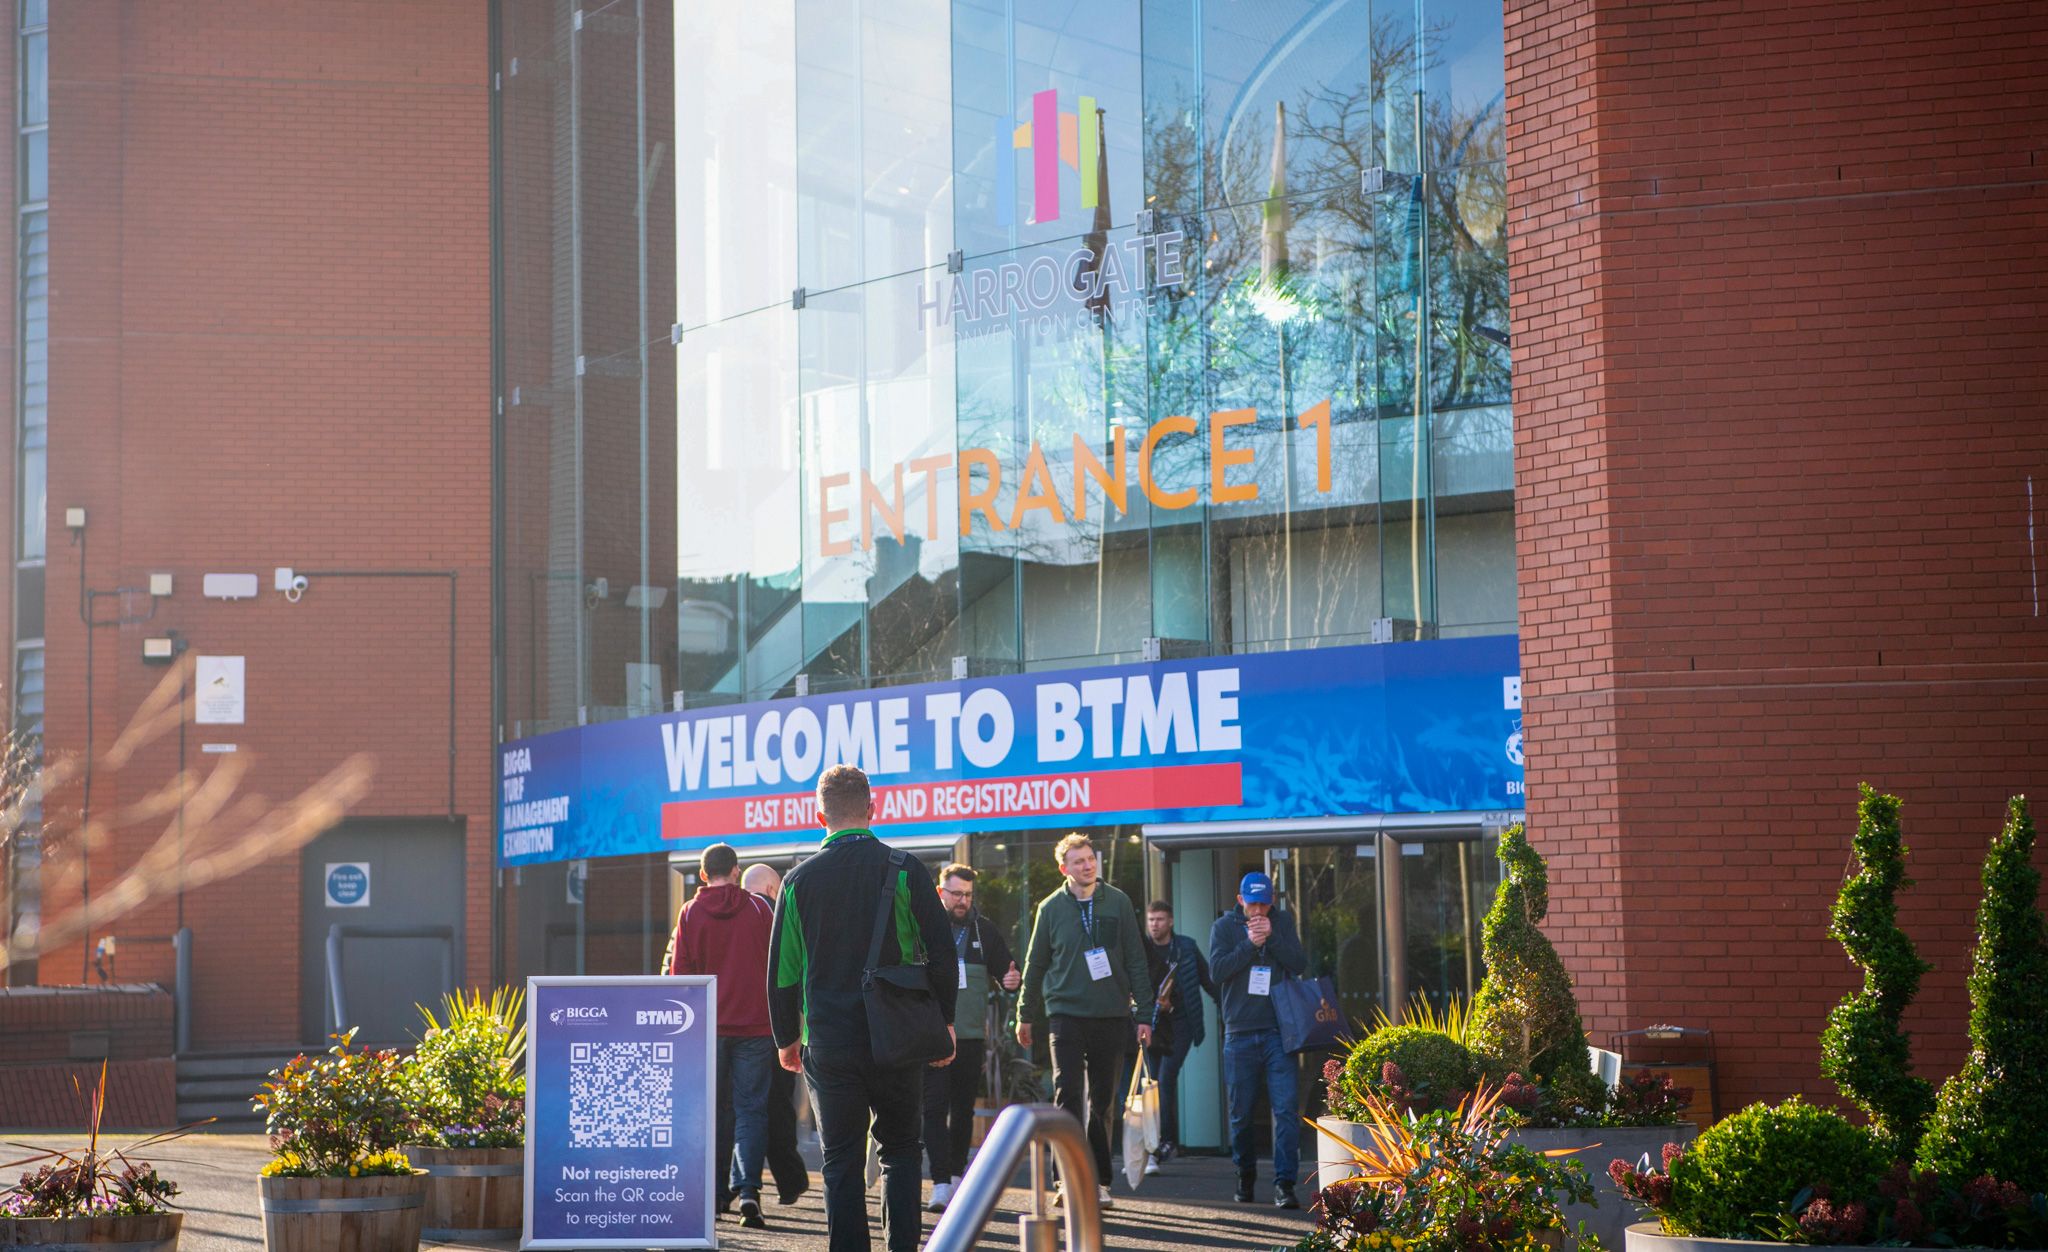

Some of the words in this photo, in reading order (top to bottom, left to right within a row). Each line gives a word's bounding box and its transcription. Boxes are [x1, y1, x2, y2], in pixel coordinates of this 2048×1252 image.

[916, 230, 1184, 333] HARROGATE
[1076, 296, 1156, 329] CENTRE
[820, 406, 1258, 557] ENTRANCE
[1299, 398, 1332, 494] 1
[661, 697, 910, 792] WELCOME
[925, 688, 1015, 769] TO
[1036, 668, 1242, 762] BTME
[504, 748, 532, 776] BIGGA
[504, 776, 525, 803] TURF
[745, 798, 779, 829] EAST
[882, 786, 927, 819] AND
[933, 778, 1090, 817] REGISTRATION
[504, 796, 569, 830] MANAGEMENT
[504, 826, 554, 857] EXHIBITION
[566, 1007, 608, 1018] BIGGA
[636, 1011, 683, 1025] BTME
[562, 1166, 590, 1180] Not
[594, 1164, 679, 1184] registered?
[555, 1187, 589, 1202] Scan
[595, 1186, 617, 1202] the
[621, 1187, 644, 1202] QR
[649, 1186, 685, 1202] code
[566, 1212, 580, 1224] to
[585, 1211, 636, 1228] register
[640, 1213, 673, 1224] now.
